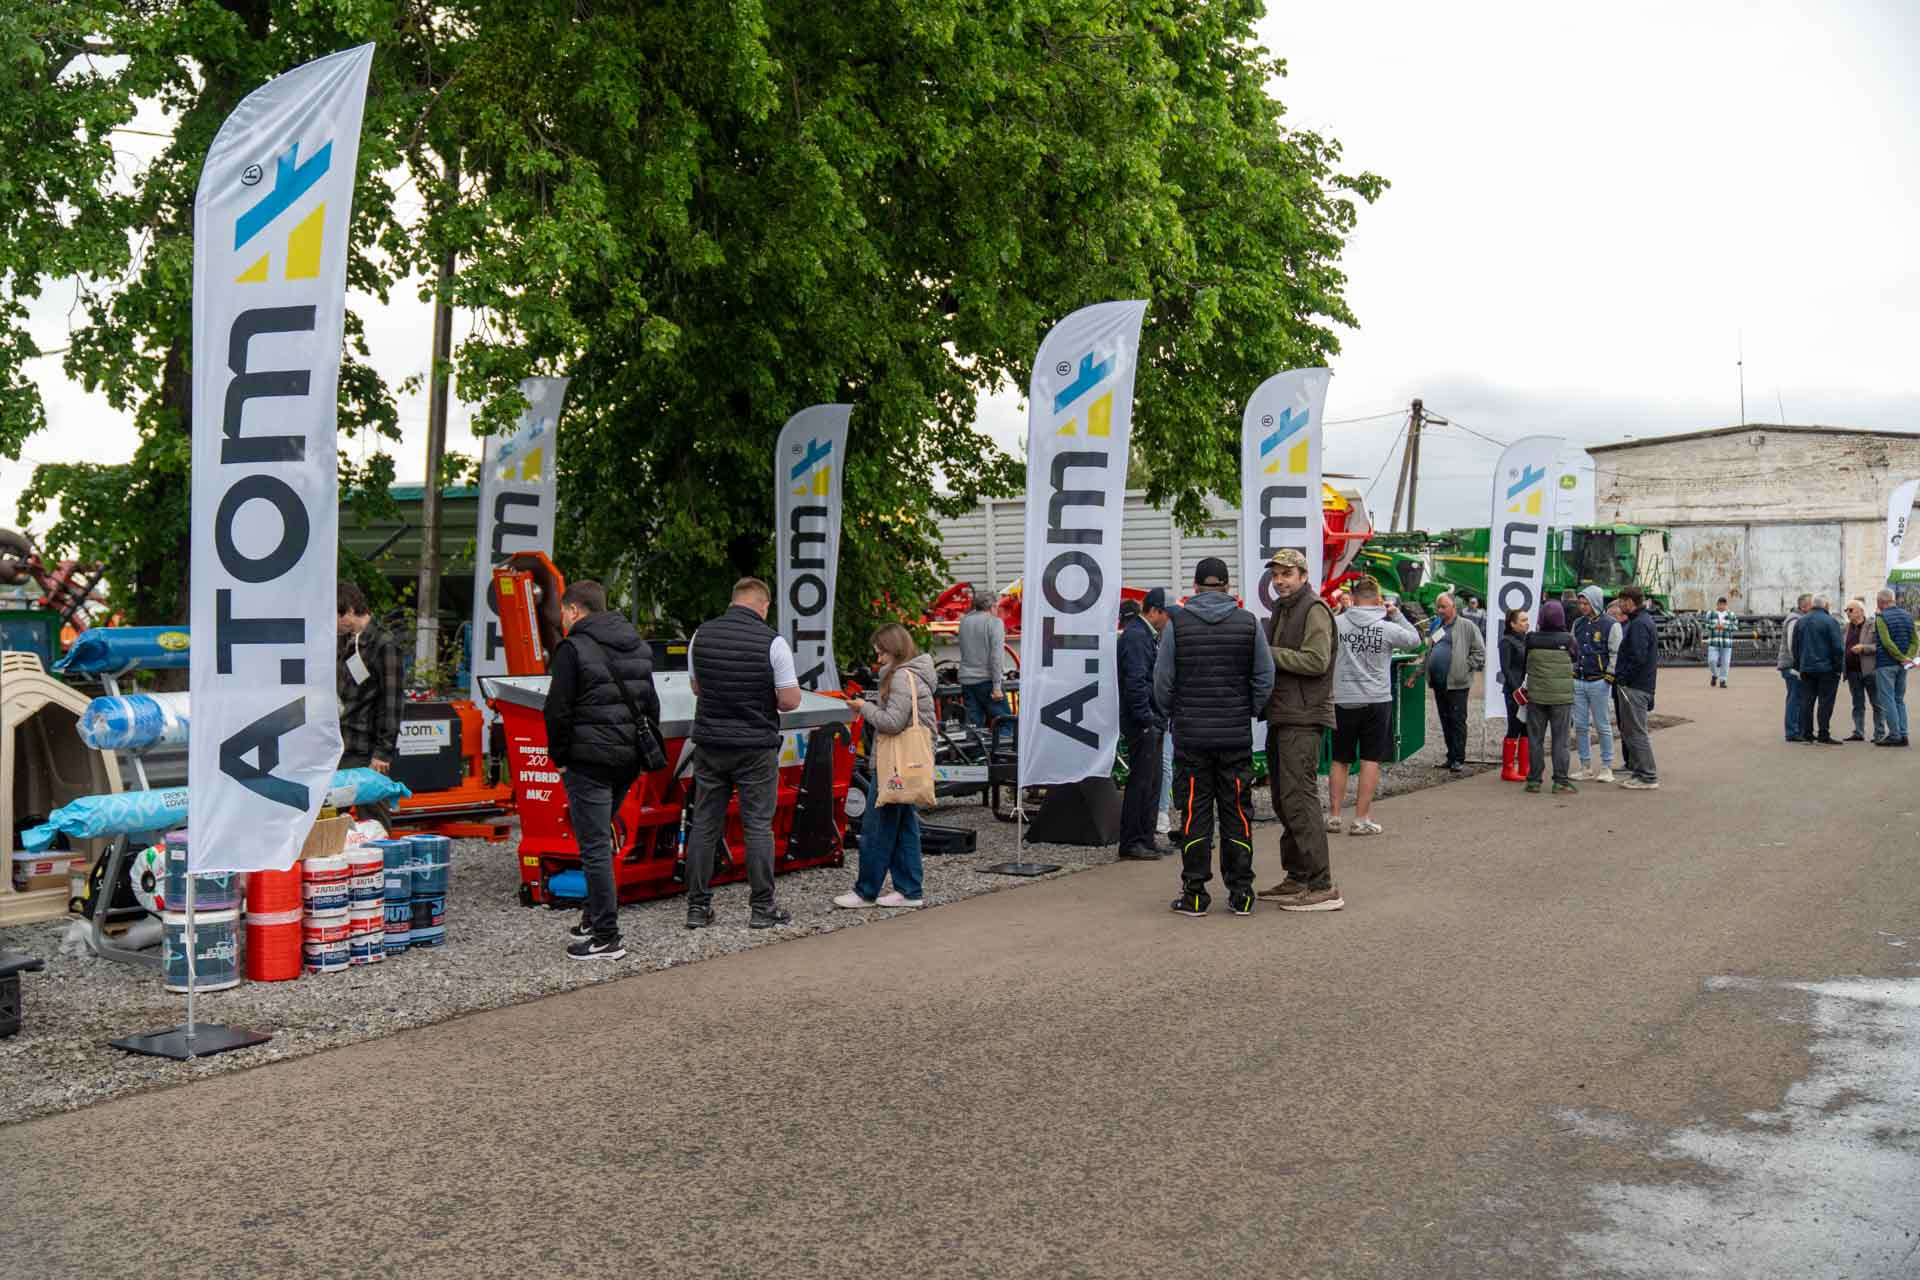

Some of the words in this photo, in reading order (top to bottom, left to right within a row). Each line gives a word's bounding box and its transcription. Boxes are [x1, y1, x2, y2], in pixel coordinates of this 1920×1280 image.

[1361, 626, 1383, 637] THE
[1339, 633, 1383, 645] NORTH
[1351, 643, 1381, 653] FACE
[527, 754, 548, 766] 200
[519, 771, 560, 783] HYBRID
